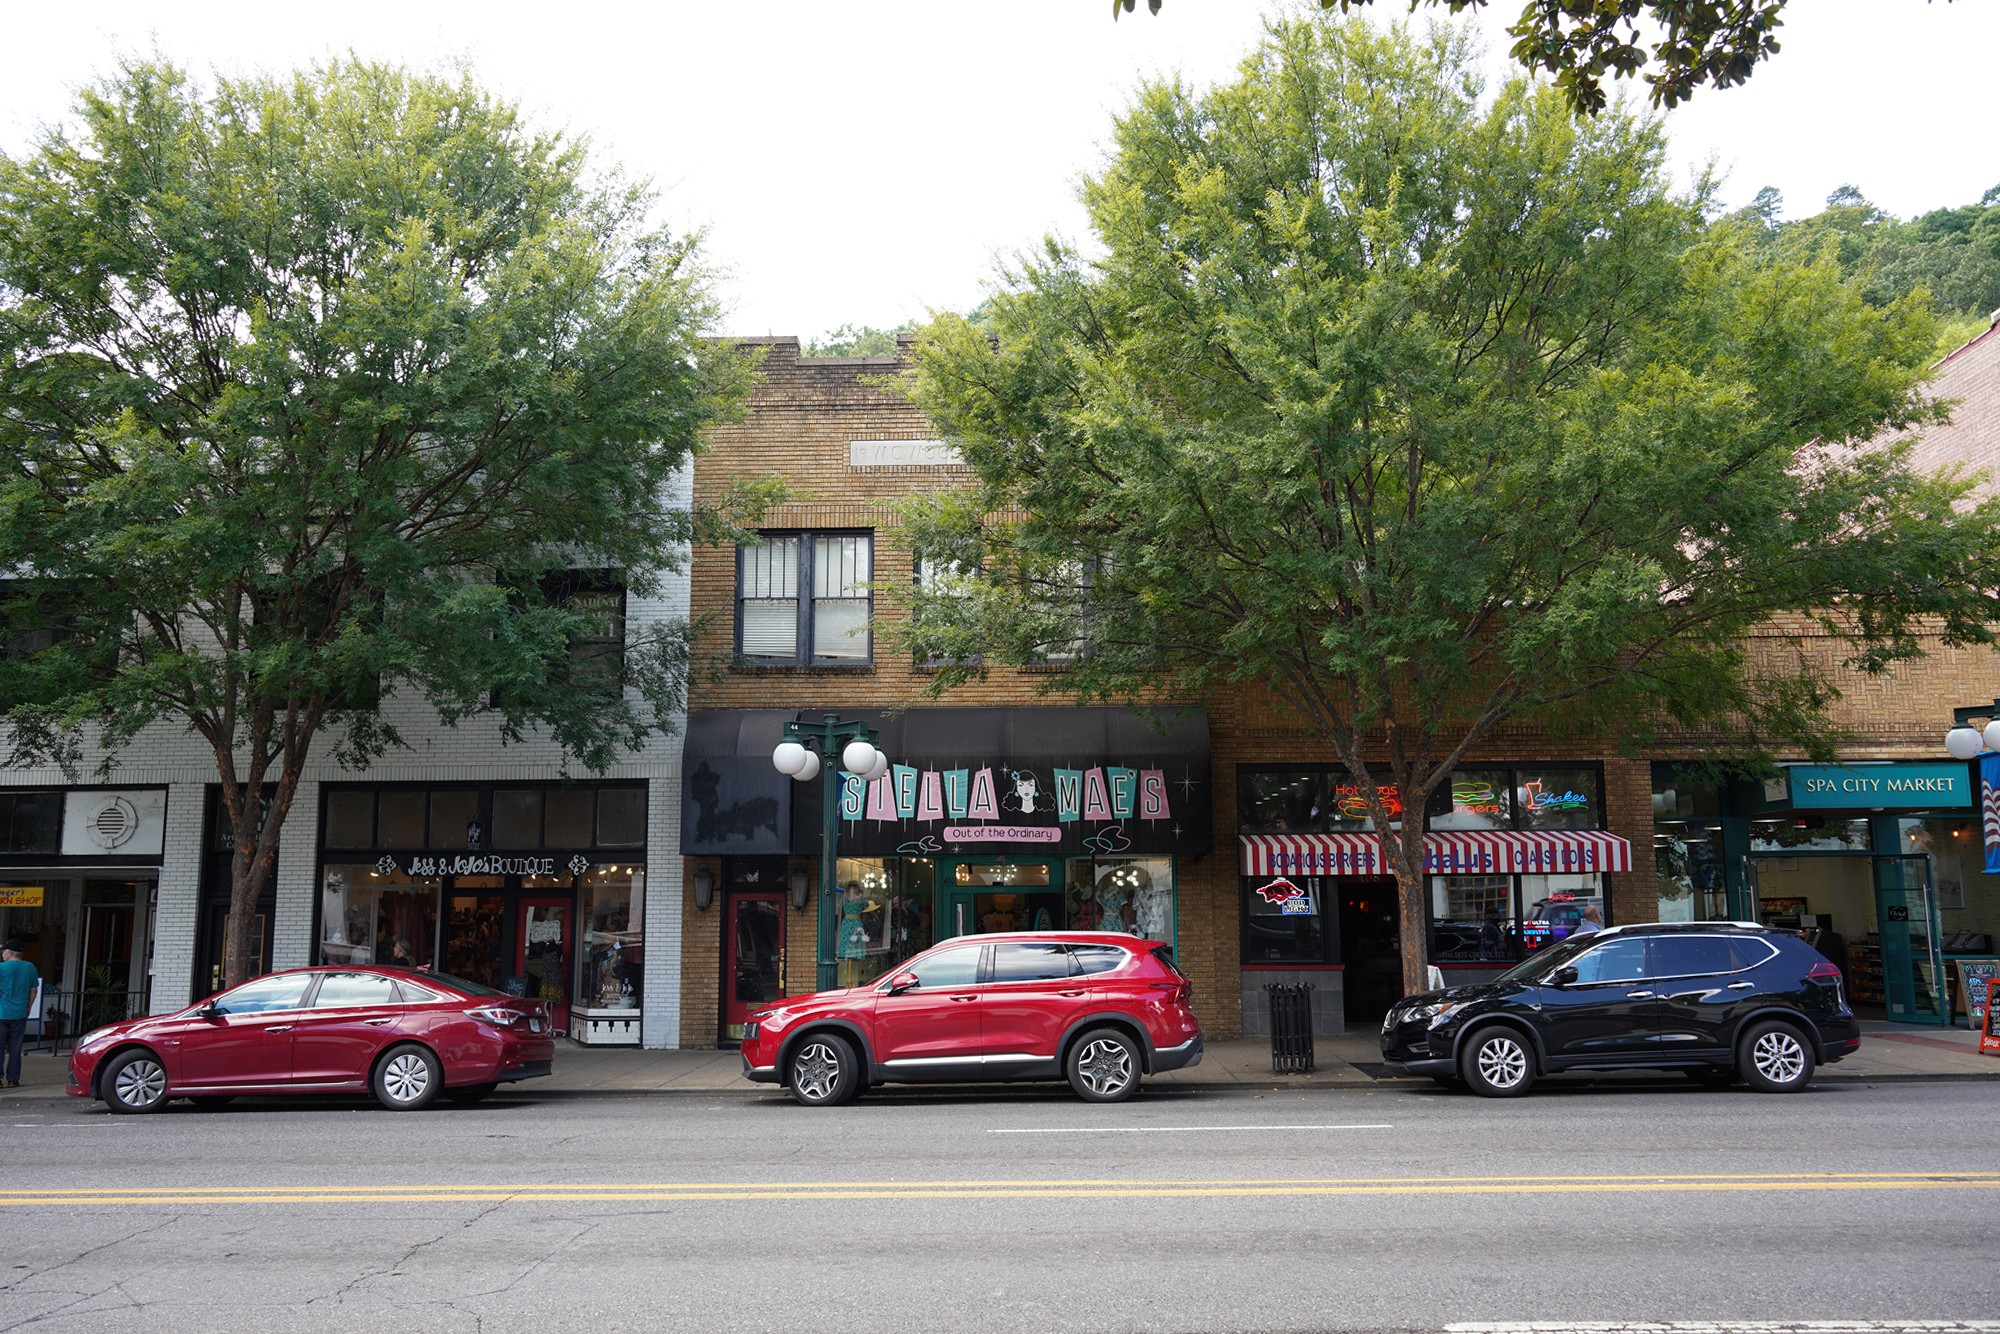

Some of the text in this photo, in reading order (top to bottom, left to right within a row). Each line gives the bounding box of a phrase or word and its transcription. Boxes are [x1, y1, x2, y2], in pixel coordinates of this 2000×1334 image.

[1335, 784, 1398, 798] Hot ogs
[1807, 778, 1955, 792] SPA CITY MARKET
[845, 771, 1162, 814] STELLA MAE'S
[1533, 791, 1587, 806] Shakes
[1452, 804, 1499, 814] urgers
[953, 828, 1053, 842] Out of the Ordinary
[1270, 853, 1326, 868] BODACIOUS
[1329, 853, 1376, 868] BURGERS
[1514, 850, 1558, 865] CLASSY
[1562, 849, 1593, 865] DOGS
[408, 856, 435, 876] Jess
[438, 857, 448, 876] &
[1548, 893, 1575, 902] OPEN
